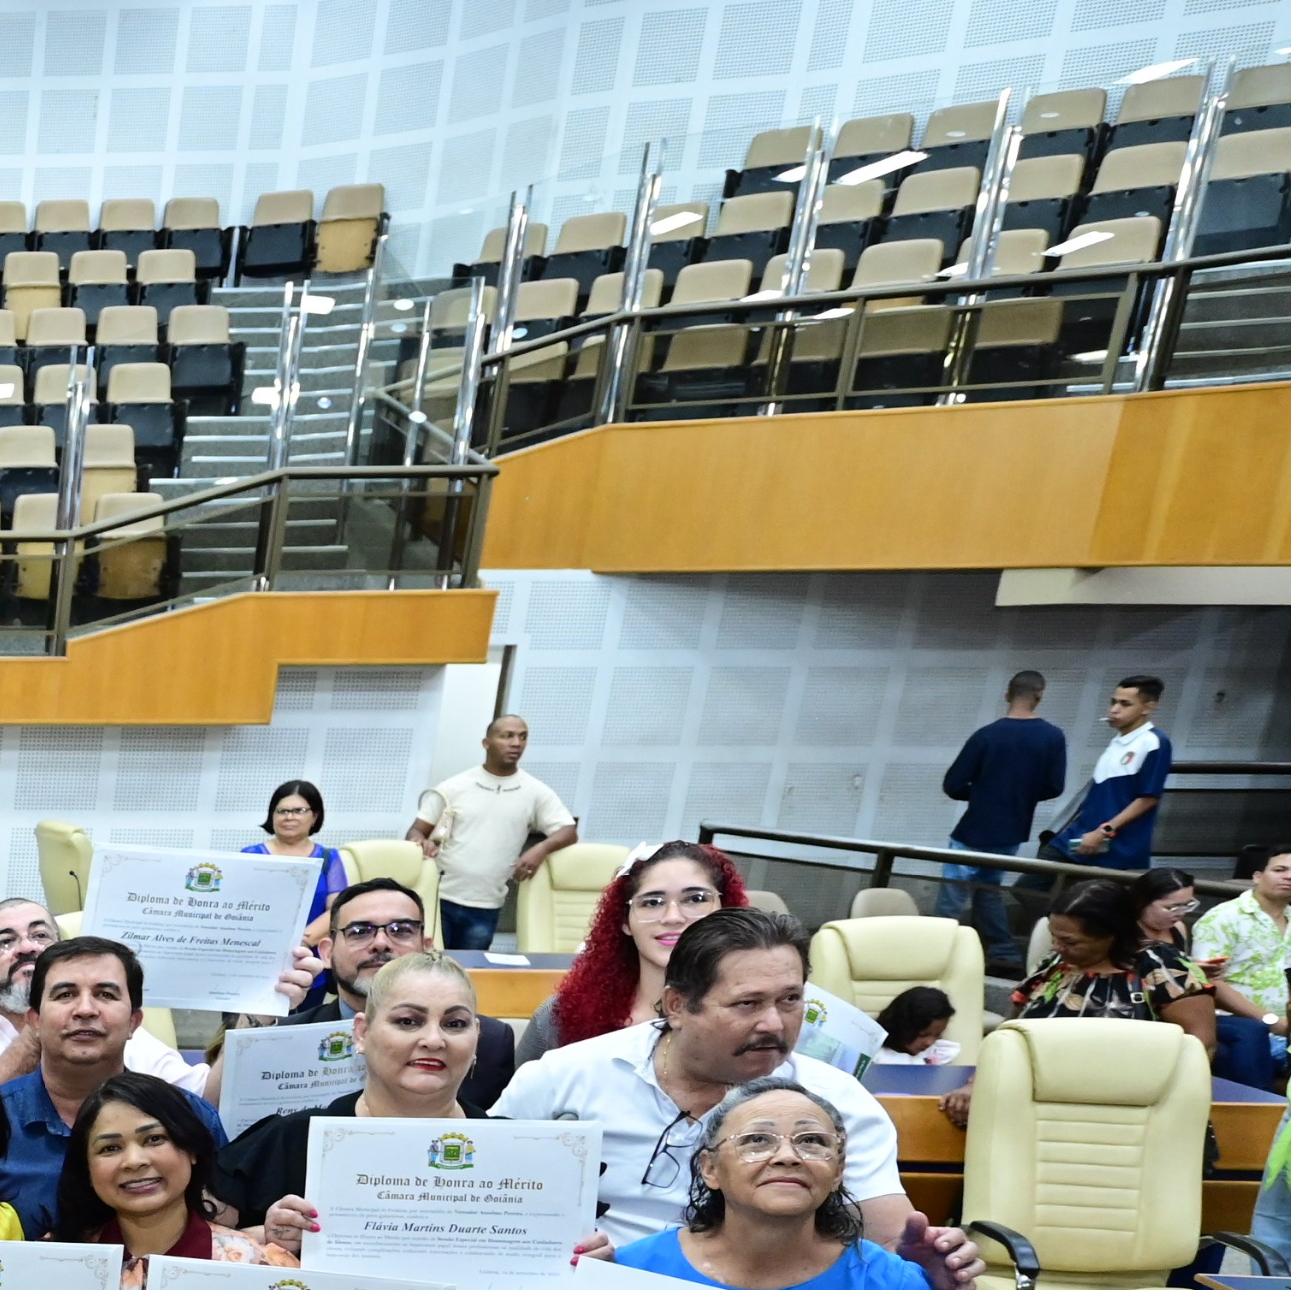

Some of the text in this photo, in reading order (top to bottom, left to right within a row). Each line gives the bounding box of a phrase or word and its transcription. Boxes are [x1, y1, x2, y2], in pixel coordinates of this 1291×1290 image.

[121, 932, 150, 940] Zilmar
[190, 936, 218, 944] Freitas
[222, 938, 261, 946] Menescal
[356, 1174, 410, 1186] Diploma
[414, 1177, 428, 1186] de
[433, 1176, 474, 1188] Honra
[497, 1178, 542, 1190] Mérito
[377, 1191, 414, 1200] Câmara
[418, 1193, 467, 1202] Municipal
[484, 1194, 522, 1203] Goiânia
[363, 1222, 526, 1234] Flávia Martins Duarte Santos
